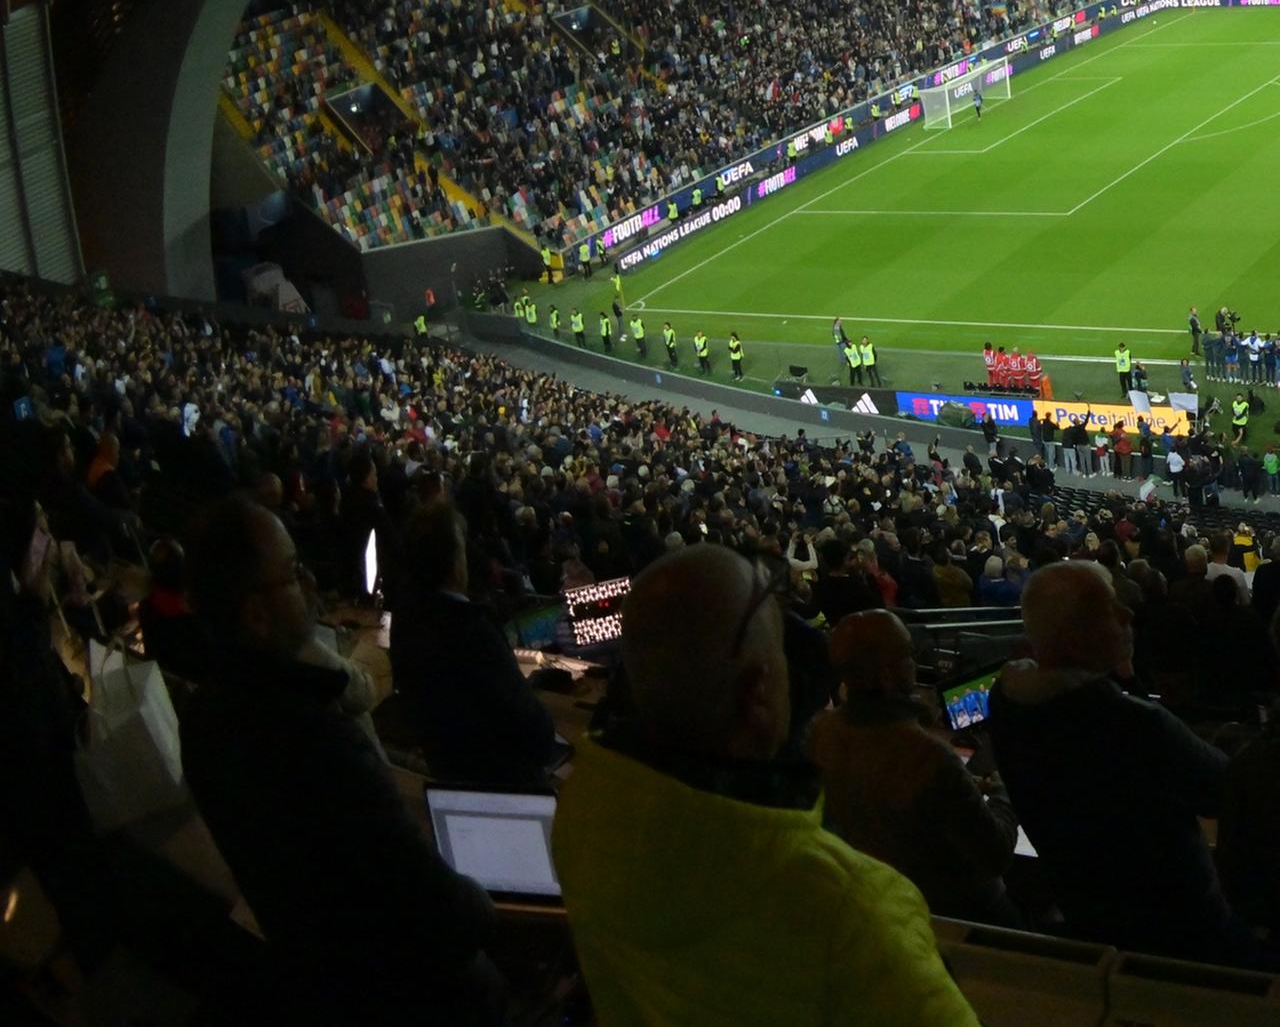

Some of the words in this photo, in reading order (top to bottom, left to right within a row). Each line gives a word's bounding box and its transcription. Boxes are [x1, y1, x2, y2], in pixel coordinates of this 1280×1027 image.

[836, 136, 859, 157] UEFA
[720, 161, 754, 185] UEFA
[603, 204, 661, 249] #FOOTBALL
[619, 250, 644, 271] UEFA
[643, 230, 679, 258] NATIONS
[679, 213, 712, 239] LEAGUE
[711, 195, 742, 223] 00:00
[987, 402, 1019, 421] TIM
